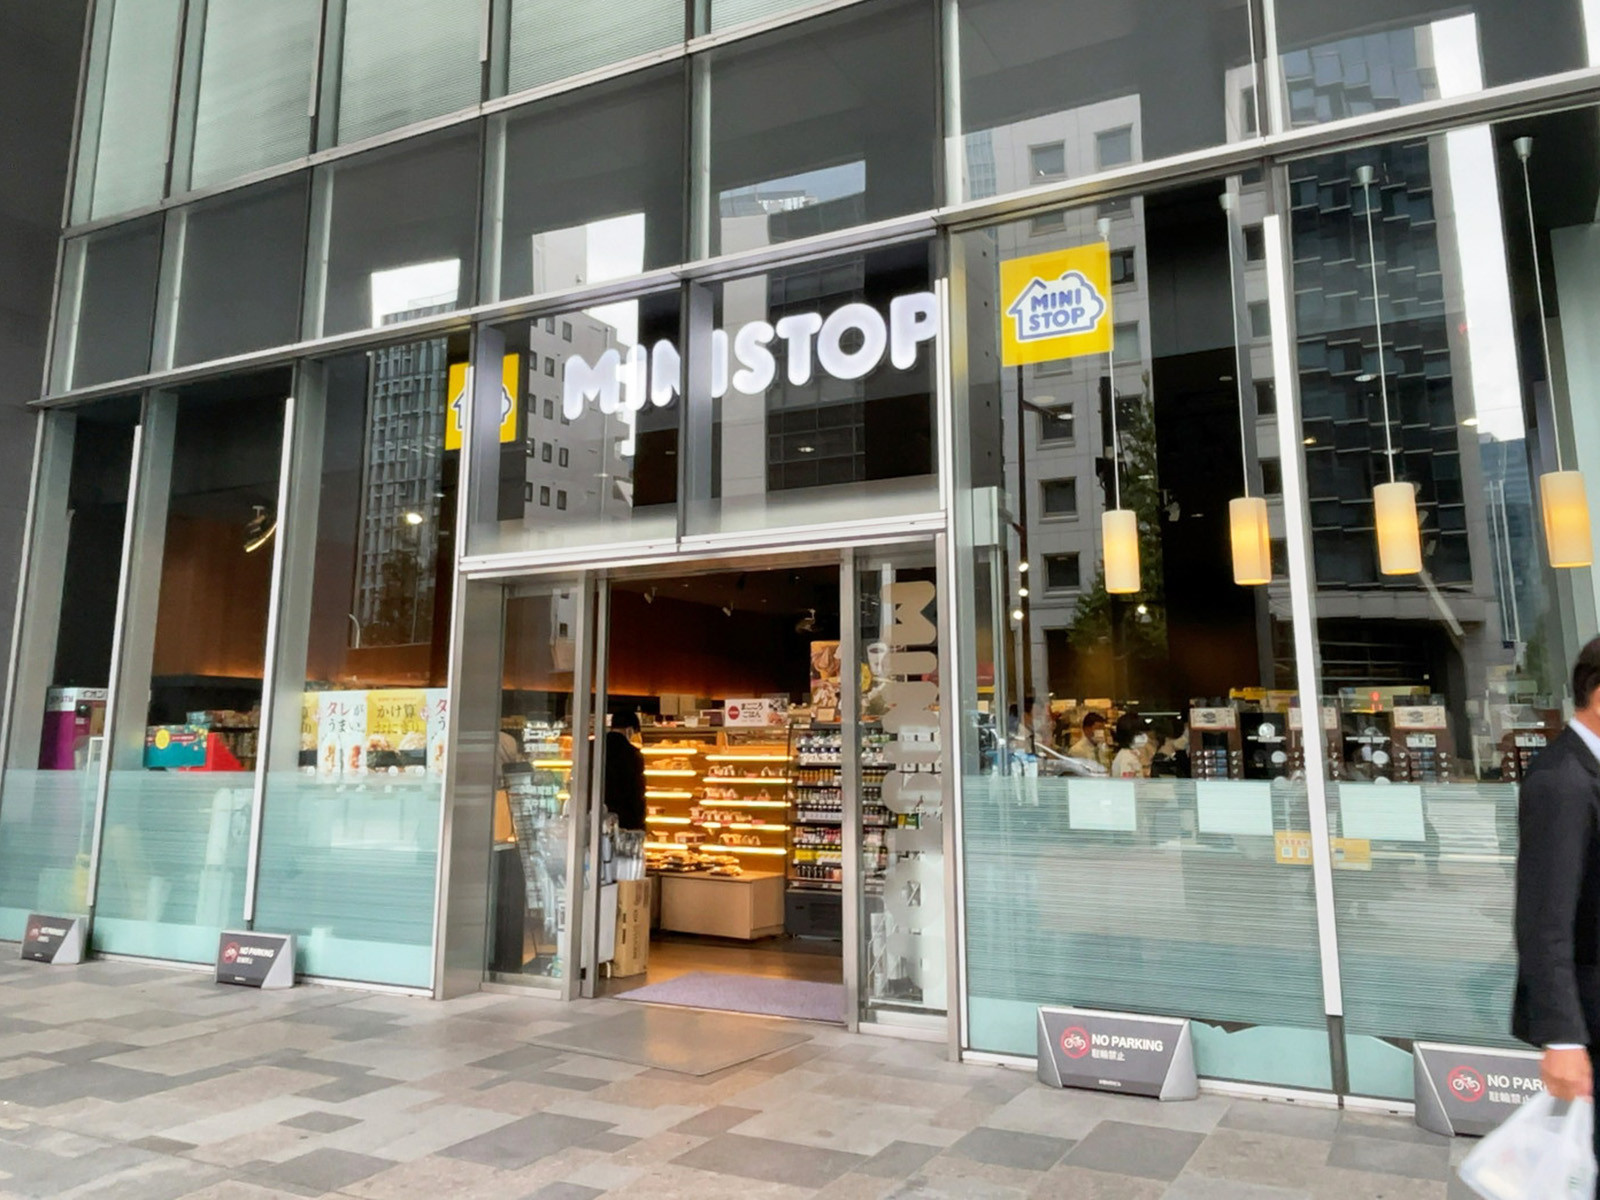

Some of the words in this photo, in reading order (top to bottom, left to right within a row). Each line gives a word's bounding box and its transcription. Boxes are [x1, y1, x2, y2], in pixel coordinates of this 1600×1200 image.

[1030, 288, 1081, 312] MINI
[1029, 307, 1085, 332] STOP
[562, 291, 937, 421] MINISTOP
[376, 704, 416, 718] かけ算
[1092, 1034, 1109, 1046] NO
[1111, 1036, 1163, 1052] PARKING
[1487, 1074, 1510, 1088] NO
